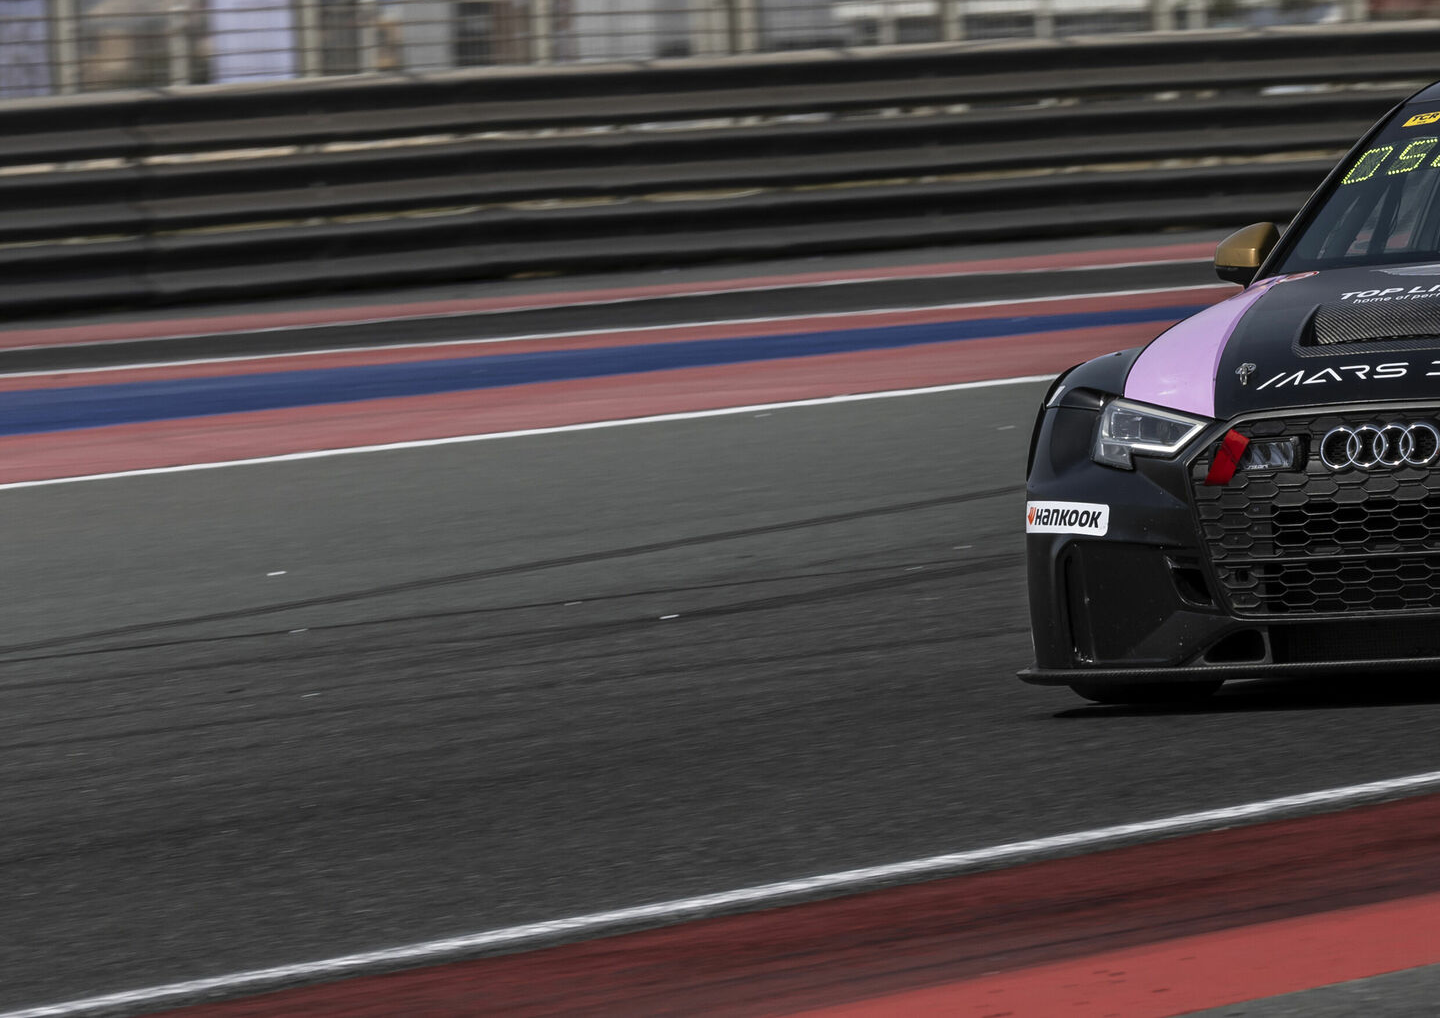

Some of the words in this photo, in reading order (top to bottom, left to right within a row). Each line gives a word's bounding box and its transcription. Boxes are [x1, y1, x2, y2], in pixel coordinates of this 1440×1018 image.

[1340, 287, 1405, 301] TOP
[1352, 296, 1392, 304] home
[1395, 293, 1412, 302] of
[1256, 361, 1409, 391] MARS
